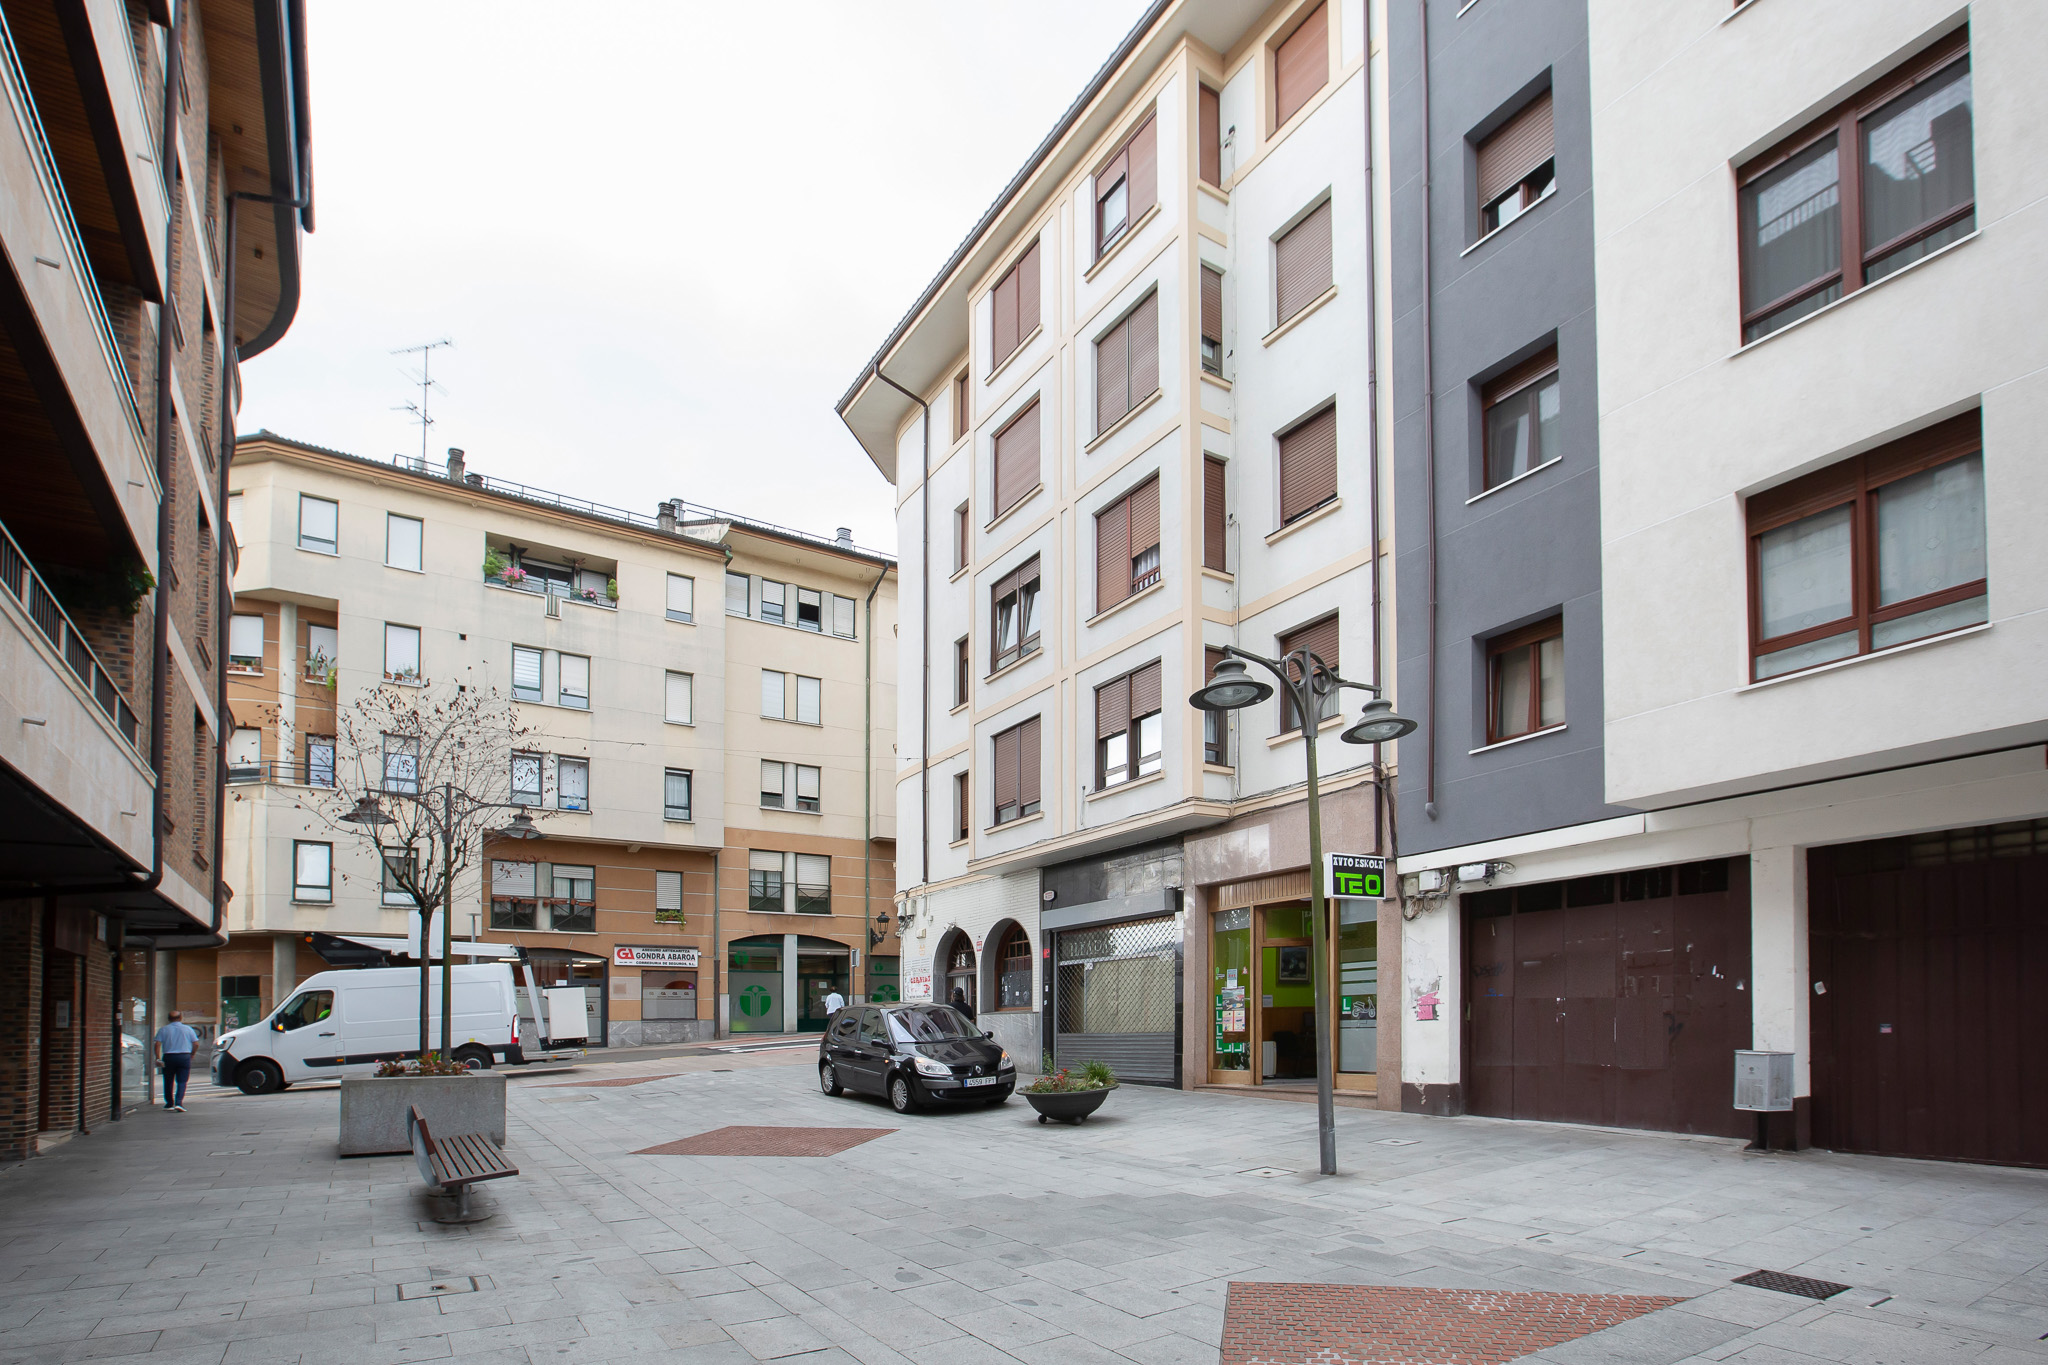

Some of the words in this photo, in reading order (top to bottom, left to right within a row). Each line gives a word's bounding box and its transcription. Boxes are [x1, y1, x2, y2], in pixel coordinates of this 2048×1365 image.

[1354, 858, 1384, 870] ESKOLA
[1335, 872, 1380, 895] TEO
[616, 948, 635, 960] GA
[1343, 998, 1350, 1010] L
